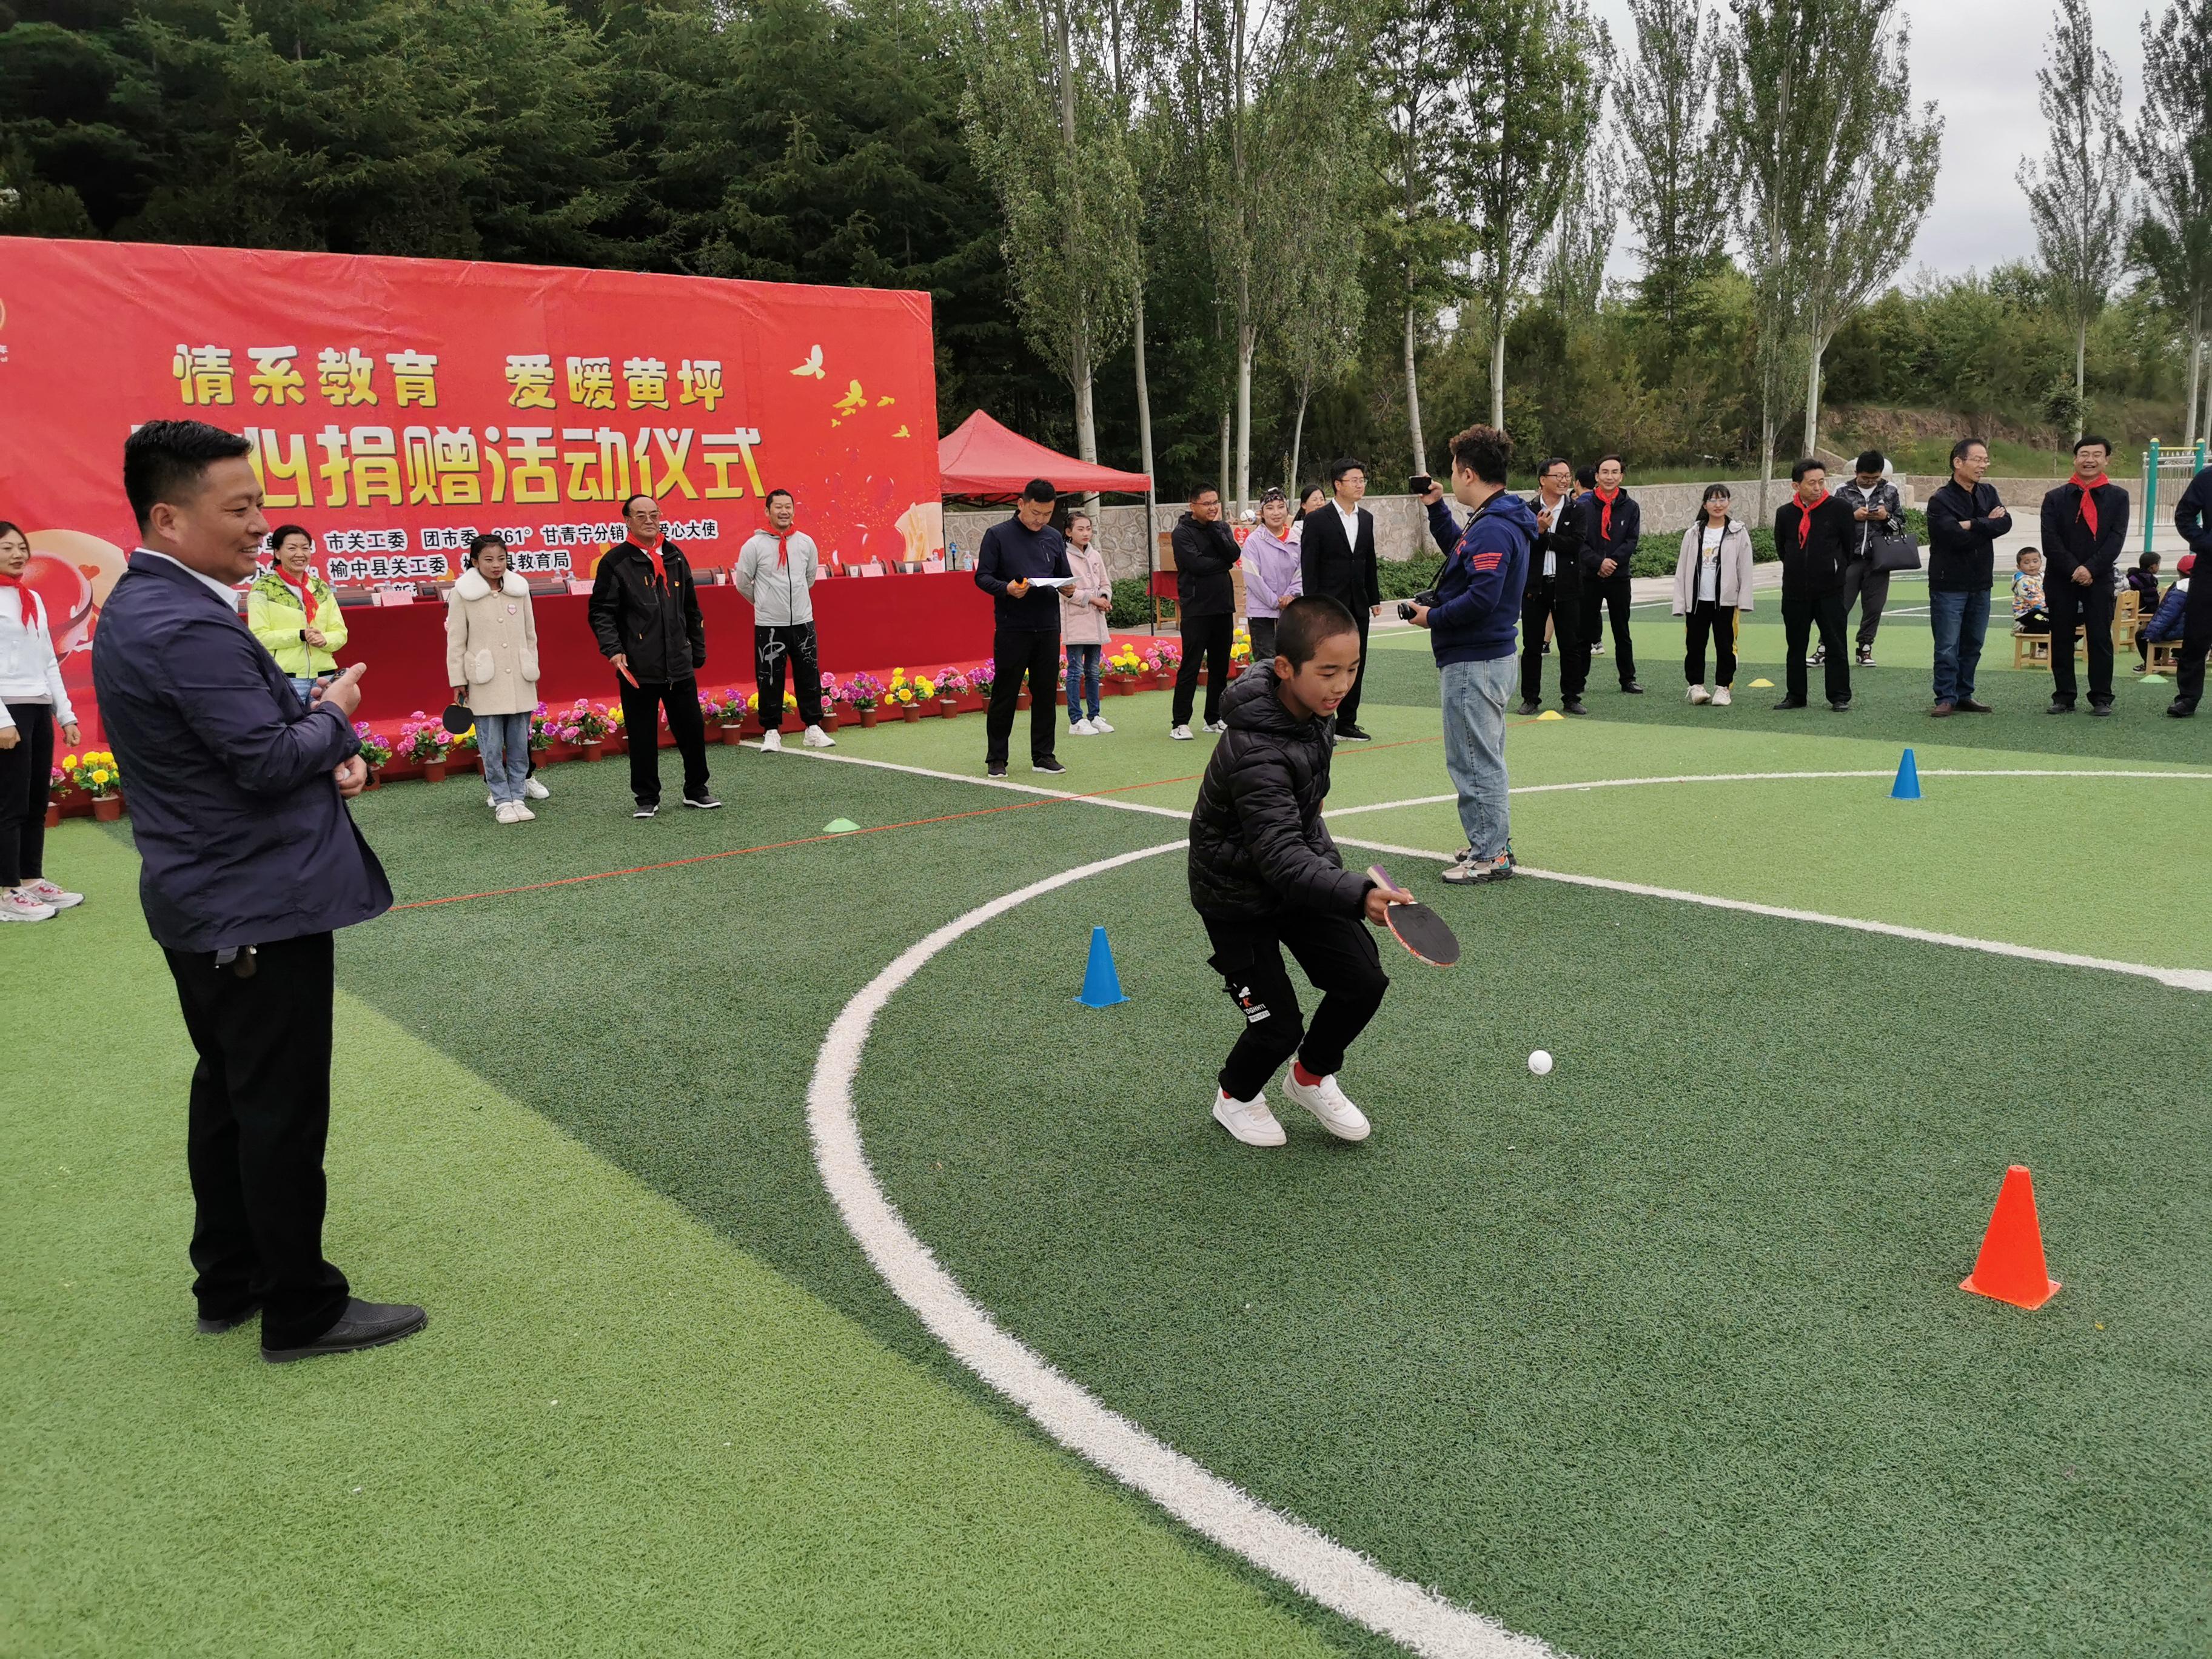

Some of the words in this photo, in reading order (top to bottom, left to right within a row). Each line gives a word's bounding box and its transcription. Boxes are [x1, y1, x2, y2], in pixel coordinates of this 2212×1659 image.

[173, 344, 438, 407] 情系教育
[505, 354, 724, 411] 爱暖黄坪
[131, 424, 765, 508] 心捐赠活动仪式
[327, 529, 405, 551] 市关工委
[423, 529, 477, 547] 团市委
[543, 525, 629, 544] 甘青宁分销
[330, 555, 446, 578] 榆中县关工委
